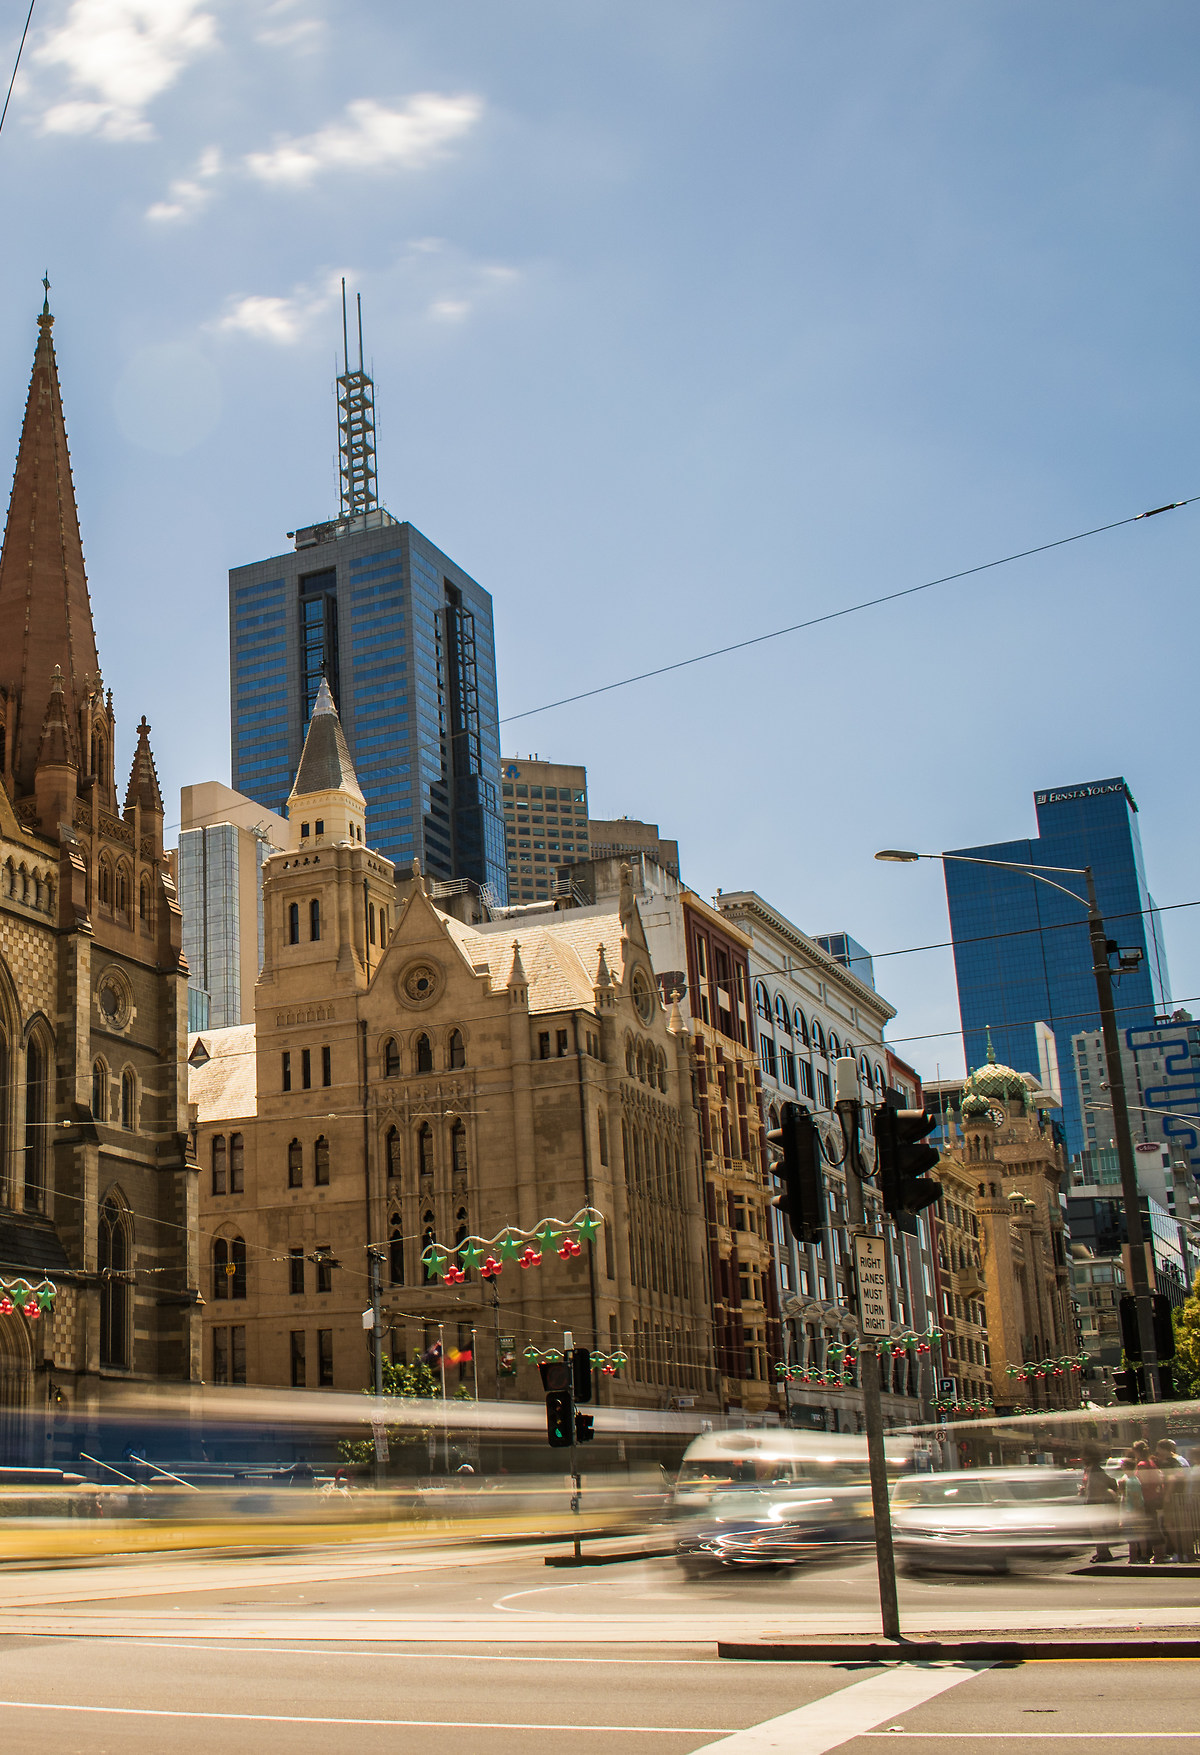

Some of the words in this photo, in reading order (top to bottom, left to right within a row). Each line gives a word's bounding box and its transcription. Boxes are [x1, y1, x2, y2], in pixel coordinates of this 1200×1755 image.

[866, 1243, 872, 1254] 2
[860, 1257, 881, 1269] RIGHT
[860, 1273, 884, 1285] LANES
[863, 1288, 883, 1300] MUST
[864, 1303, 884, 1316] TURN
[865, 1318, 886, 1330] RIGHT
